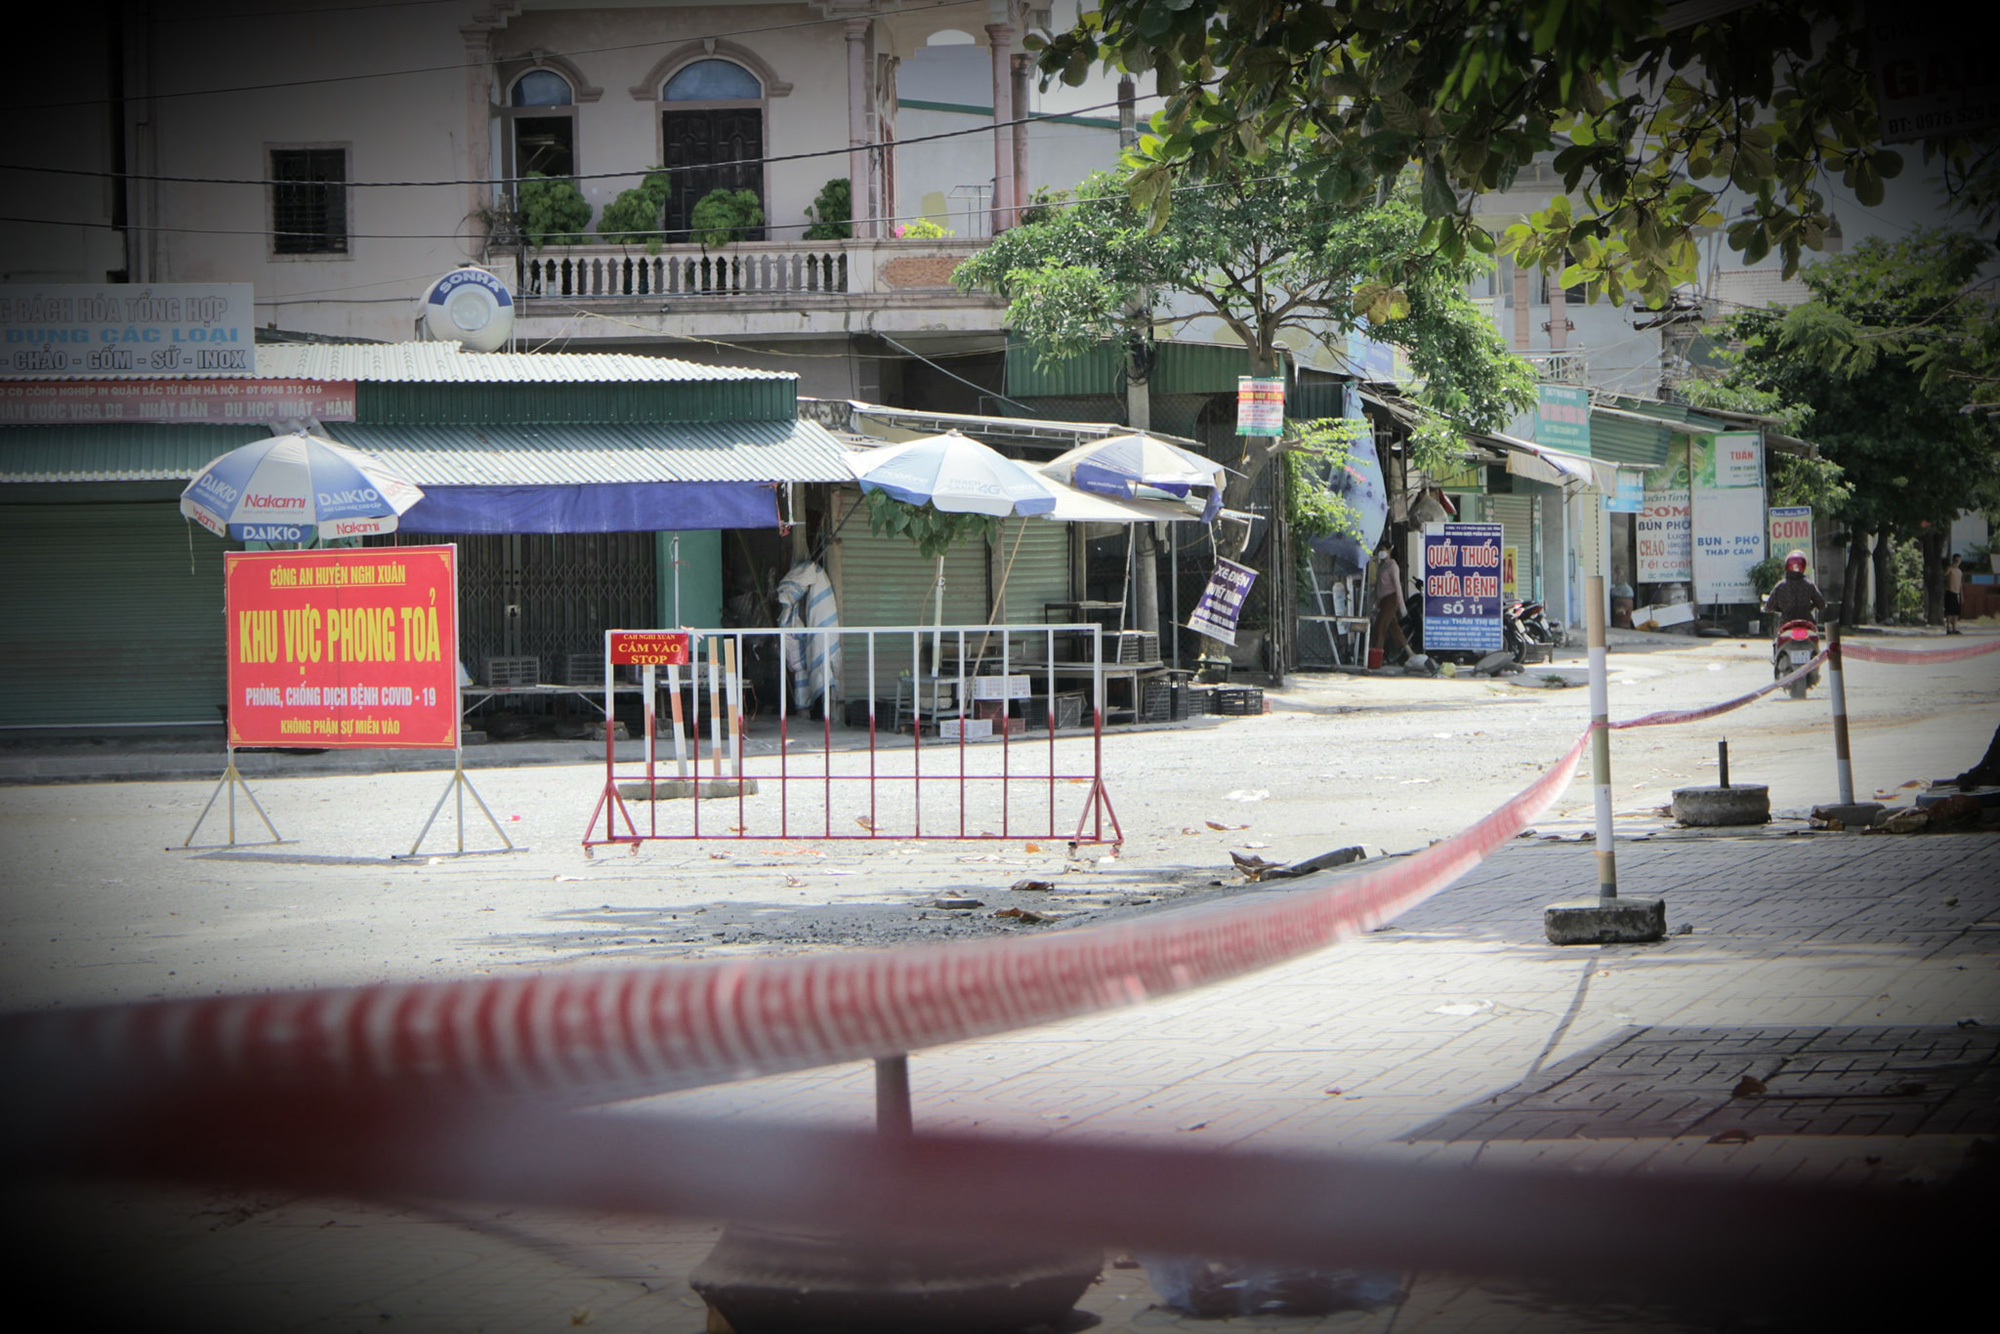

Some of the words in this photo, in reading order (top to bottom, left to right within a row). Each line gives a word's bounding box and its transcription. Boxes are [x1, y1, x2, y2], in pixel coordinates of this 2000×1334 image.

[1915, 109, 1952, 130] 0976
[440, 271, 504, 294] SONHA
[16, 292, 72, 323] BÁCH
[78, 293, 124, 323] HÓA
[126, 289, 181, 323] TỔNG
[185, 296, 229, 328] HỢP
[101, 326, 162, 343] CÁC
[172, 328, 239, 346] LOẠI
[13, 344, 68, 370] CHẢO
[87, 344, 133, 370] GỐM
[151, 345, 182, 370] SỨ
[197, 350, 247, 370] INOX
[25, 385, 57, 397] CÔNG
[60, 384, 96, 398] NGHIỆP
[143, 383, 163, 396] BẮC
[165, 384, 178, 396] TỪ
[180, 384, 201, 396] LIÊM
[203, 383, 218, 395] HÀ
[220, 384, 239, 397] NỘI
[286, 386, 304, 394] 312
[305, 385, 323, 394] 616
[29, 399, 67, 419] QUỐC
[71, 403, 100, 418] VISA
[139, 399, 176, 420] NHẬT
[224, 402, 243, 417] DU
[247, 402, 275, 420] HỌC
[278, 399, 313, 420] NHẬT
[325, 398, 353, 416] HÀN
[200, 473, 238, 503] DAIKIO
[317, 488, 379, 506] DAIKIO
[977, 484, 1001, 494] 4G
[244, 493, 307, 509] Nakami
[1639, 504, 1690, 518] CƠM
[192, 505, 217, 531] Nakami
[336, 521, 380, 535] Nakami
[1638, 518, 1662, 531] BÚN
[243, 525, 301, 540] DAIKIO
[1772, 519, 1809, 539] CƠM
[1461, 538, 1499, 568] THUỐC
[270, 565, 297, 586] CÔNG
[300, 567, 313, 585] AN
[316, 563, 350, 588] HUYỆN
[351, 565, 375, 585] NGHI
[378, 561, 406, 583] XUÂN
[1428, 570, 1461, 597] CHỮA
[1463, 571, 1498, 602] BỆNH
[1442, 600, 1465, 615] SỐ
[1469, 604, 1484, 615] 11
[239, 610, 278, 663] KHU
[283, 604, 321, 675] VỰC
[327, 607, 396, 663] PHONG
[401, 588, 441, 662] TOẢ
[618, 641, 649, 653] CẤM
[652, 641, 682, 653] VÀO
[631, 655, 668, 664] STOP
[245, 683, 283, 708] PHÒNG,
[285, 680, 321, 706] CHỐNG
[323, 686, 348, 710] DỊCH
[350, 683, 379, 709] BỆNH
[381, 687, 412, 706] COVID
[422, 687, 436, 706] 19
[280, 717, 311, 734] KHÔNG
[313, 718, 339, 737] PHẬN
[340, 718, 354, 737] SỰ
[355, 715, 379, 734] MIỄN
[382, 717, 400, 734] VÀO
